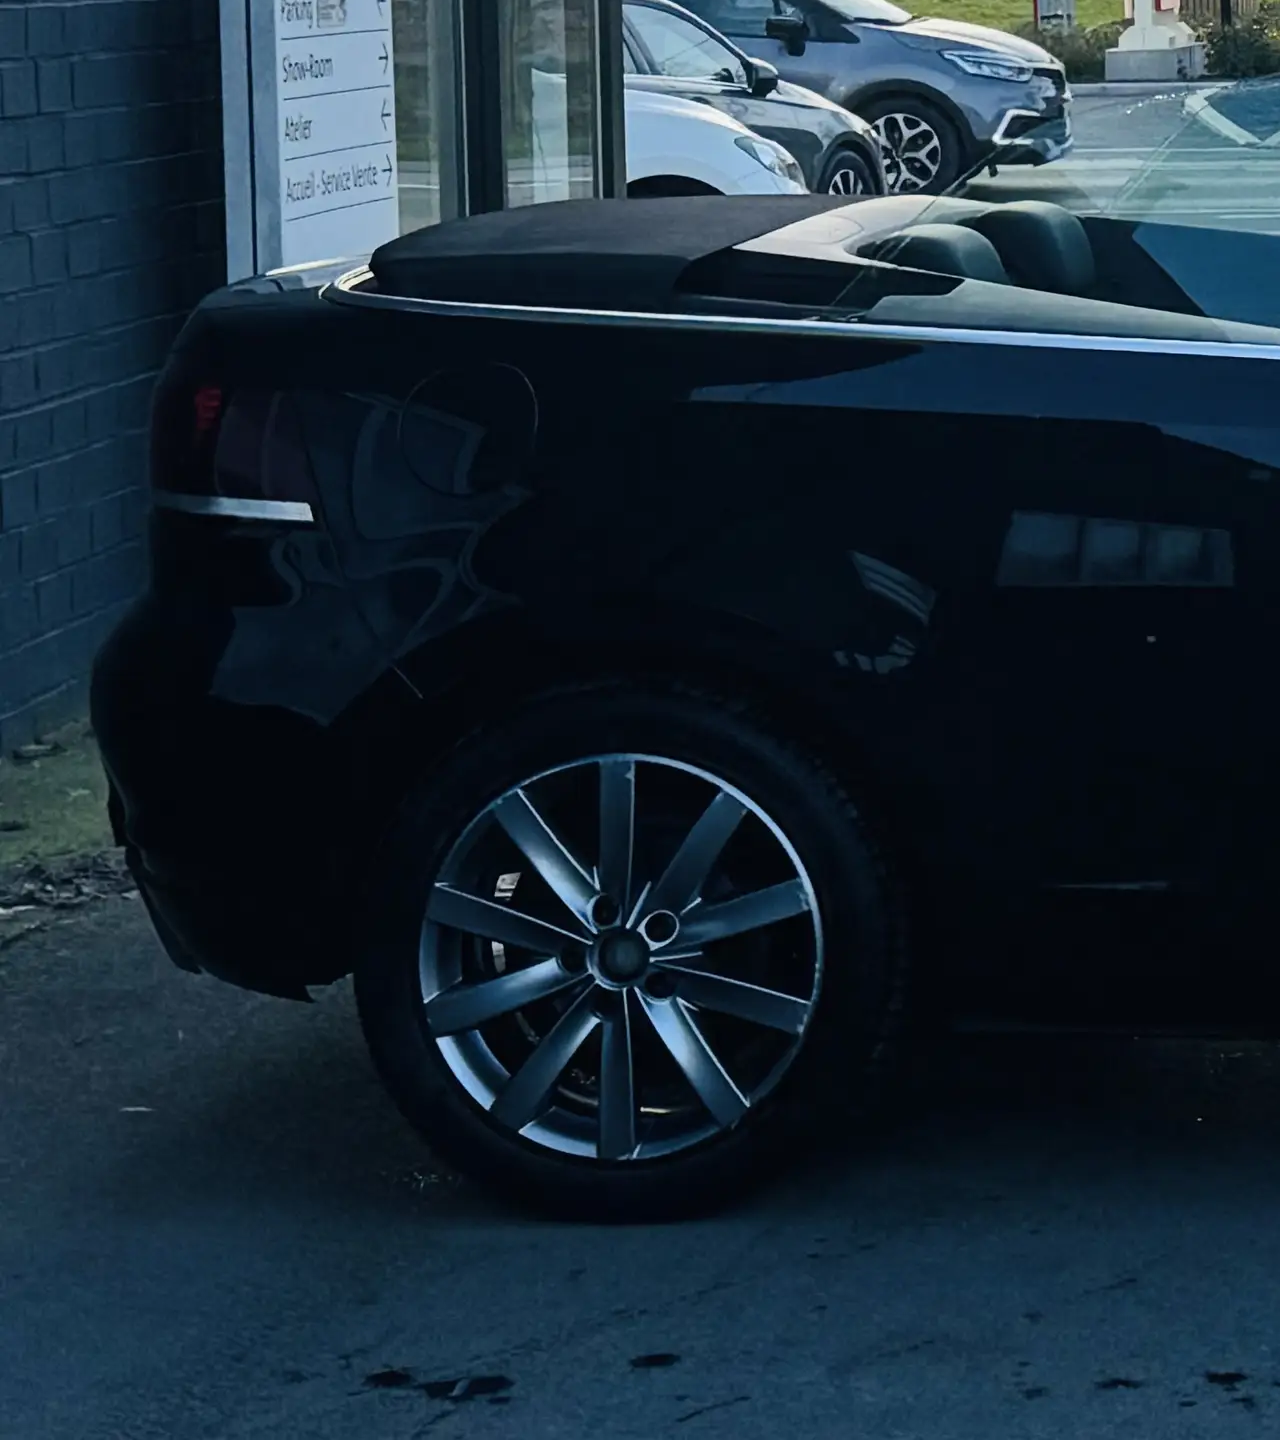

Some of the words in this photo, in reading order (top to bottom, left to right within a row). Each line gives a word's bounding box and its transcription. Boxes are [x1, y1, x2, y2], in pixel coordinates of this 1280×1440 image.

[284, 114, 313, 142] Atelier
[285, 170, 316, 204] Accueil
[321, 166, 351, 196] Service
[351, 161, 378, 188] Vente
